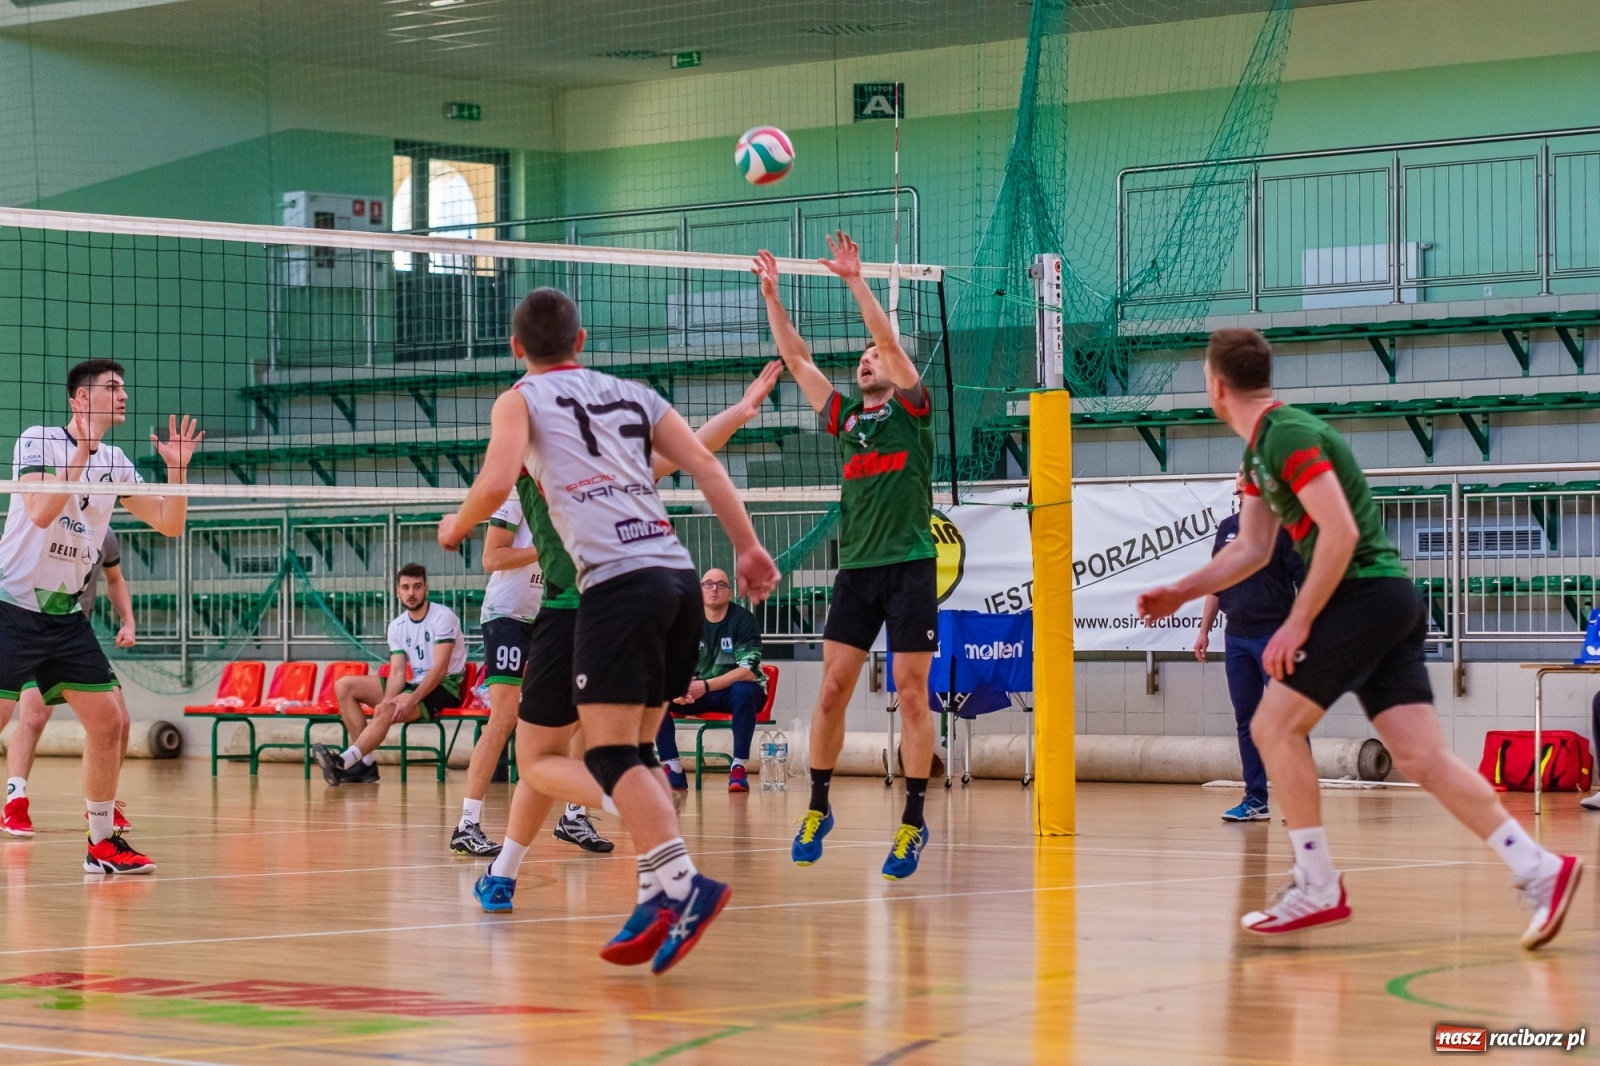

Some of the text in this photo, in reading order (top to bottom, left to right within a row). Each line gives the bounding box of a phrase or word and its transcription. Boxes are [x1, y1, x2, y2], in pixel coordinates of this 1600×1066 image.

[862, 95, 895, 115] A
[1072, 507, 1219, 586] PORZĄDKU!
[1074, 614, 1223, 632] www.osir-aciborzpl
[496, 645, 522, 671] 99
[964, 641, 1023, 660] molten
